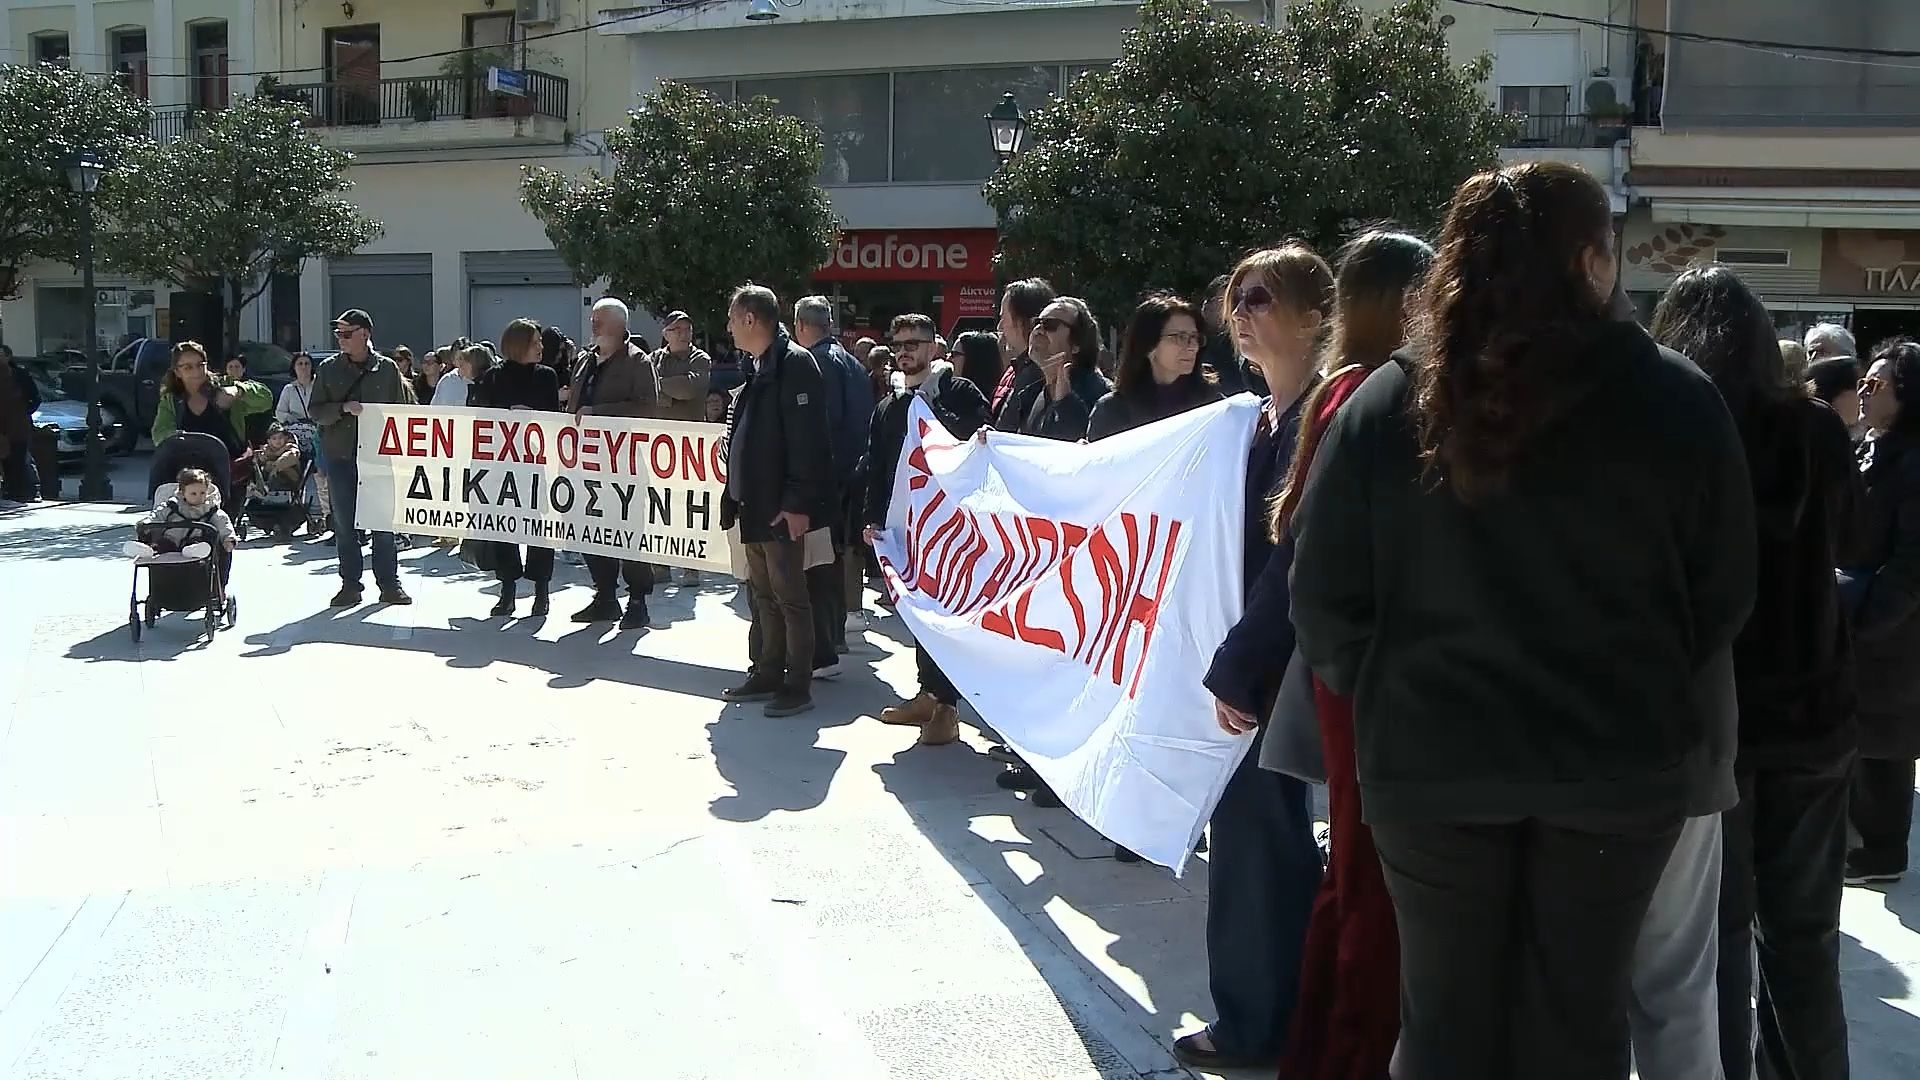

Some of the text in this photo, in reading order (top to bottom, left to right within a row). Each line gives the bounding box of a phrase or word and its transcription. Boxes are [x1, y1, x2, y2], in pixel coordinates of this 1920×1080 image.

[378, 416, 455, 459] ΔΕΝ
[471, 419, 547, 465] ΕΧΩ
[406, 465, 711, 531] ΔΙΚΑΙΟΣΥΝΗ
[404, 508, 708, 560] ΝΟΜΑΡΧΙΑΚΟ ΤΜΗΜΑ ΑΔΕΔΥ ΑΙΤ/ΝΙΑΣ
